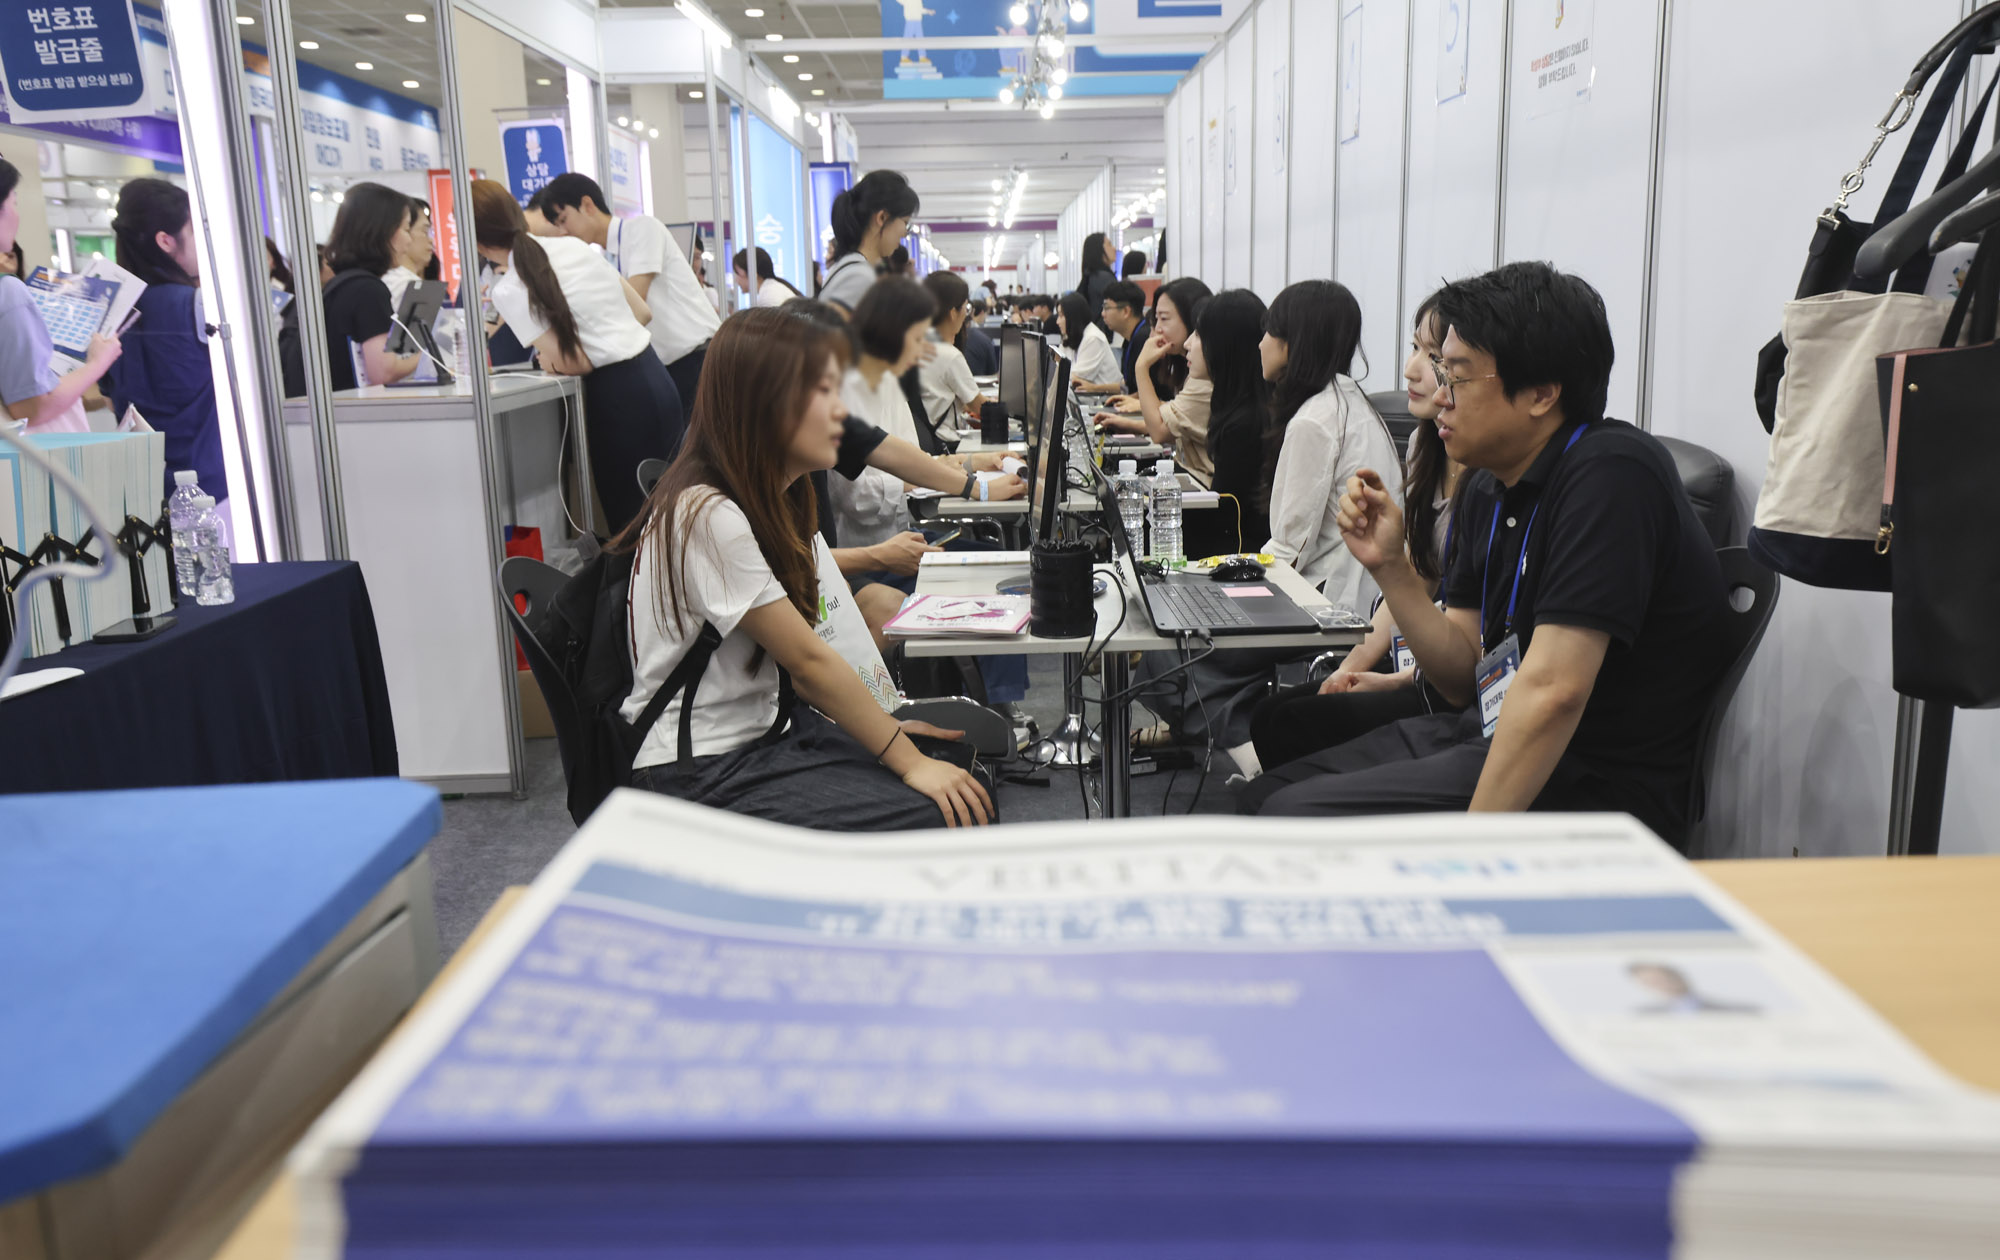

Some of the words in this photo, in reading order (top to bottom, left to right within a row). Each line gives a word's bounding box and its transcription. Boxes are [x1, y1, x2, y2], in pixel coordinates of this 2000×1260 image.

[27, 6, 98, 34] 번호표
[34, 37, 104, 66] 발급줄
[18, 78, 54, 91] (번호표
[54, 75, 75, 89] 발급
[77, 74, 108, 87] 받으실
[526, 162, 549, 177] 상담
